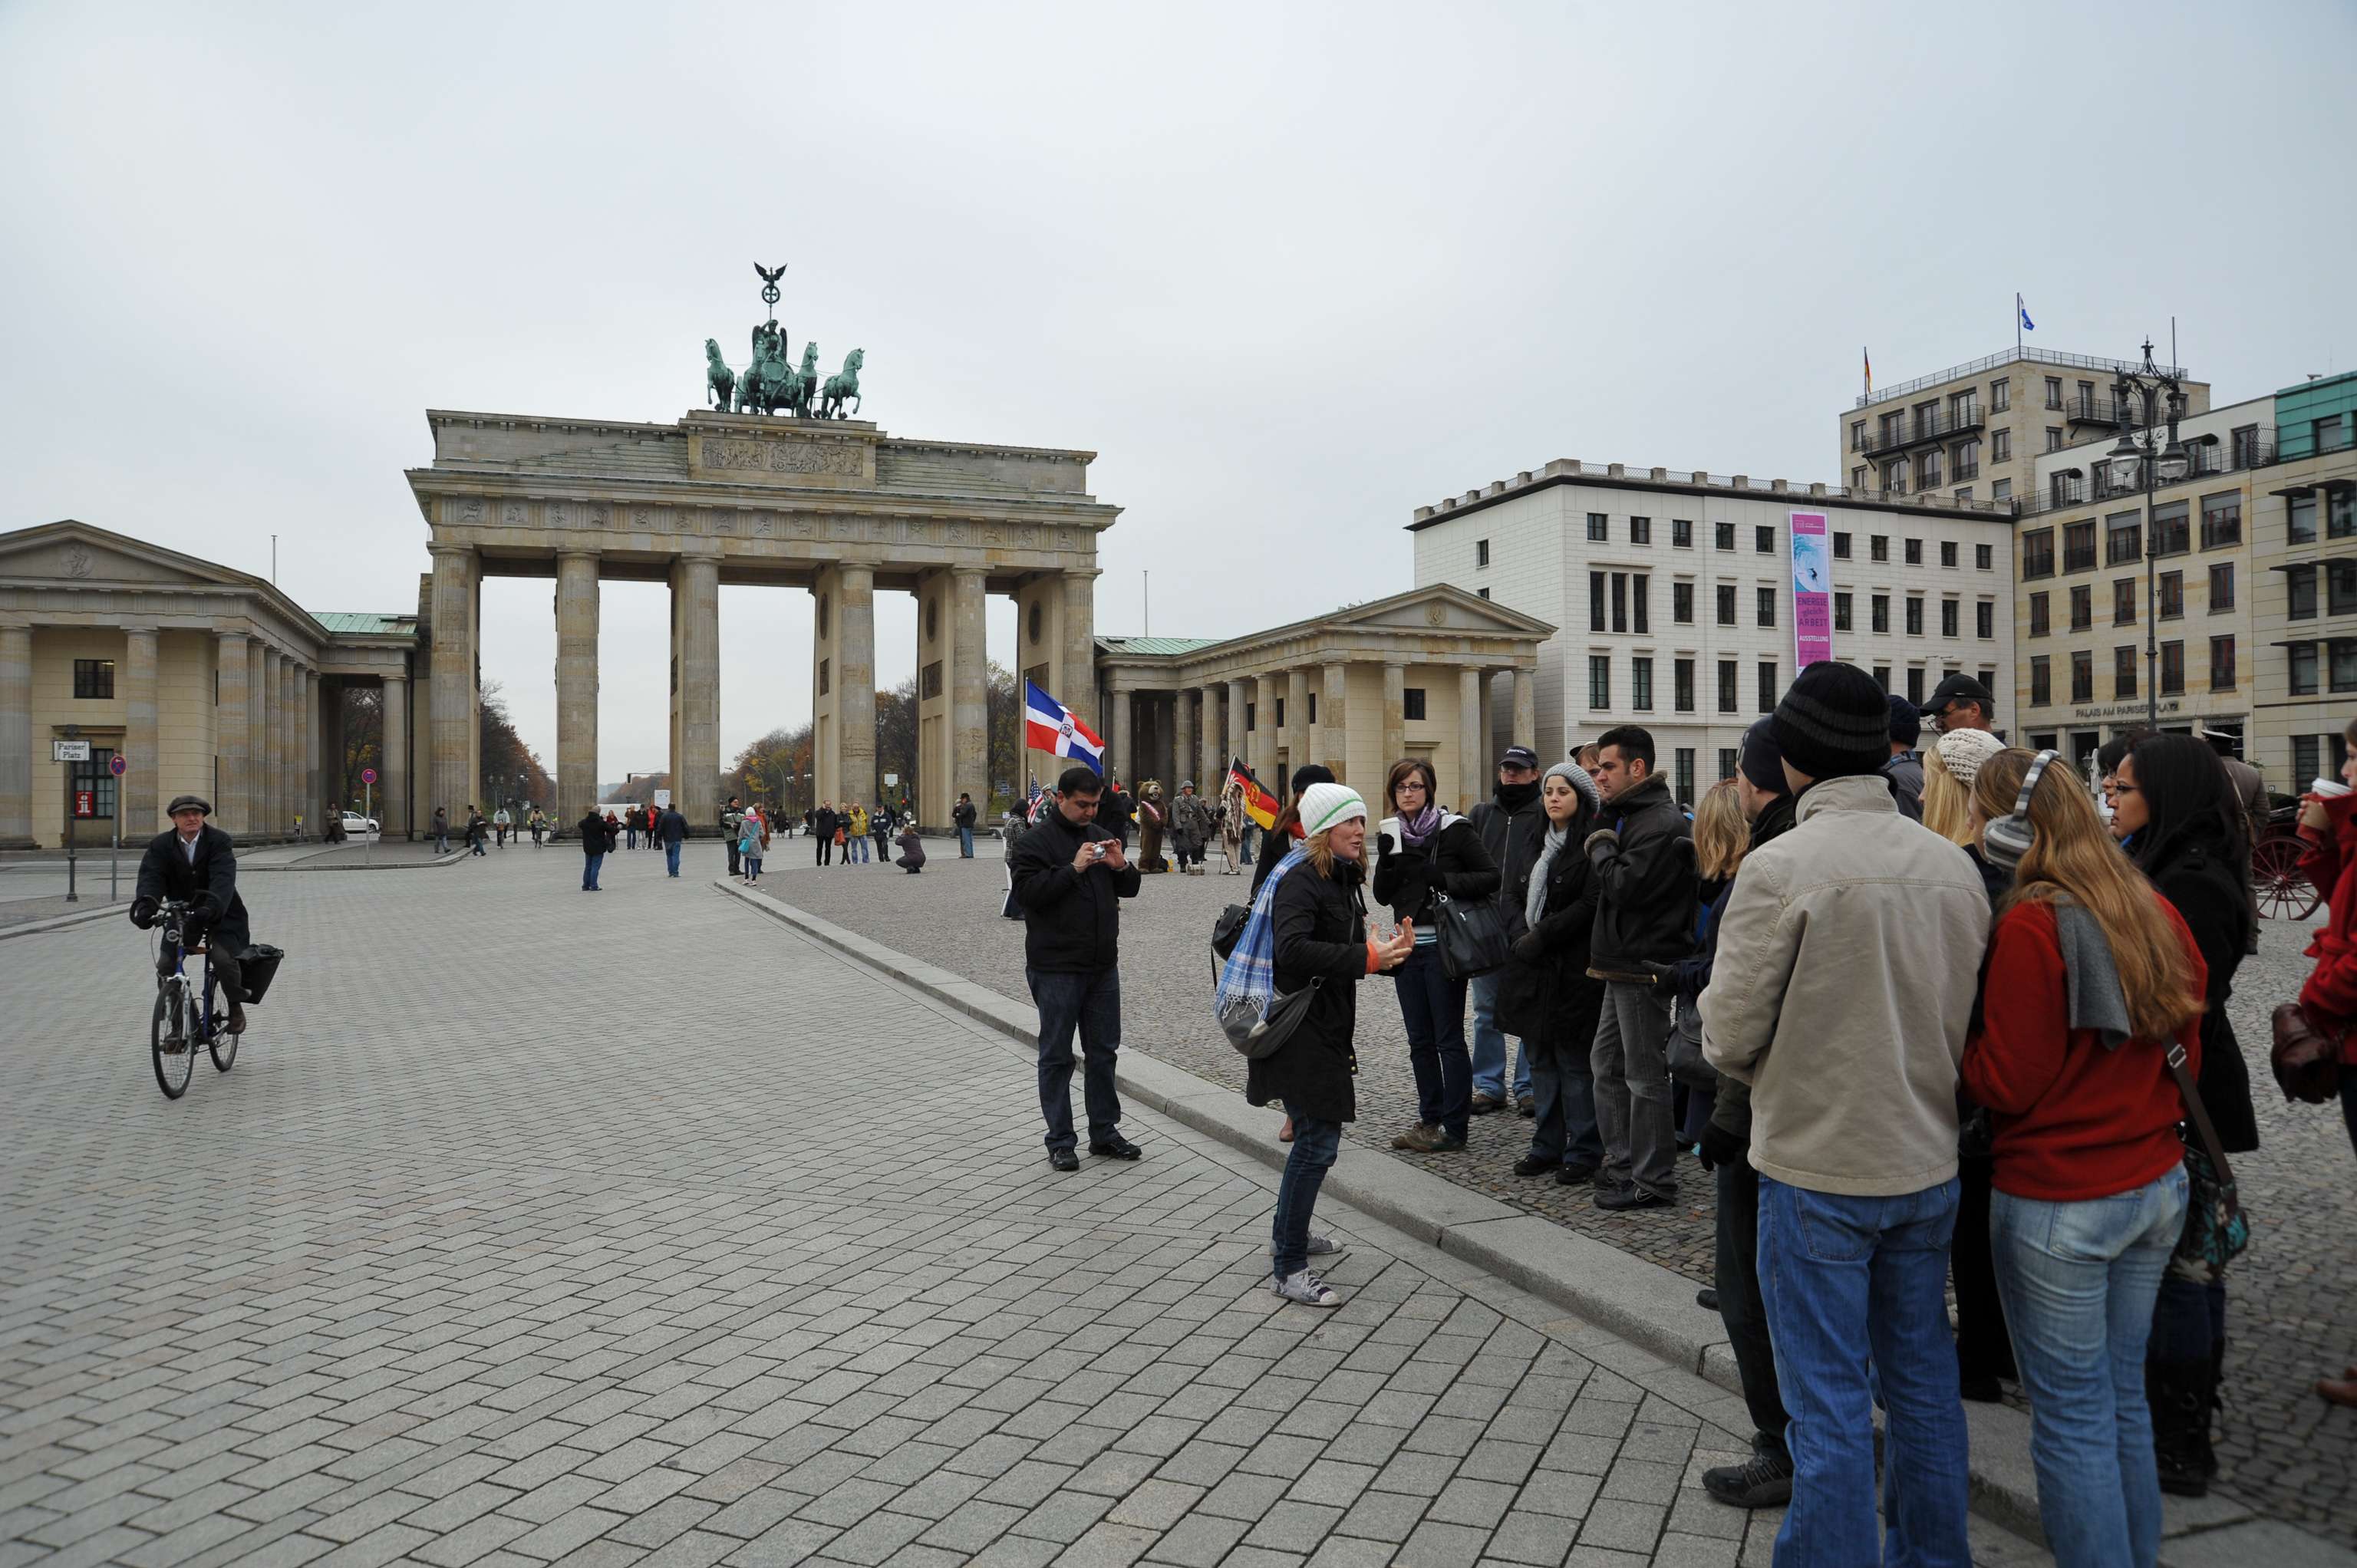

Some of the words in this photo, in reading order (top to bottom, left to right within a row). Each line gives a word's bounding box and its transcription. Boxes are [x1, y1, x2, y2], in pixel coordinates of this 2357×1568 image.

[1798, 598, 1828, 606] ENERGIE
[1798, 618, 1828, 627] ARBEIT
[2075, 708, 2101, 717] PALAIS
[2102, 707, 2115, 715] AM
